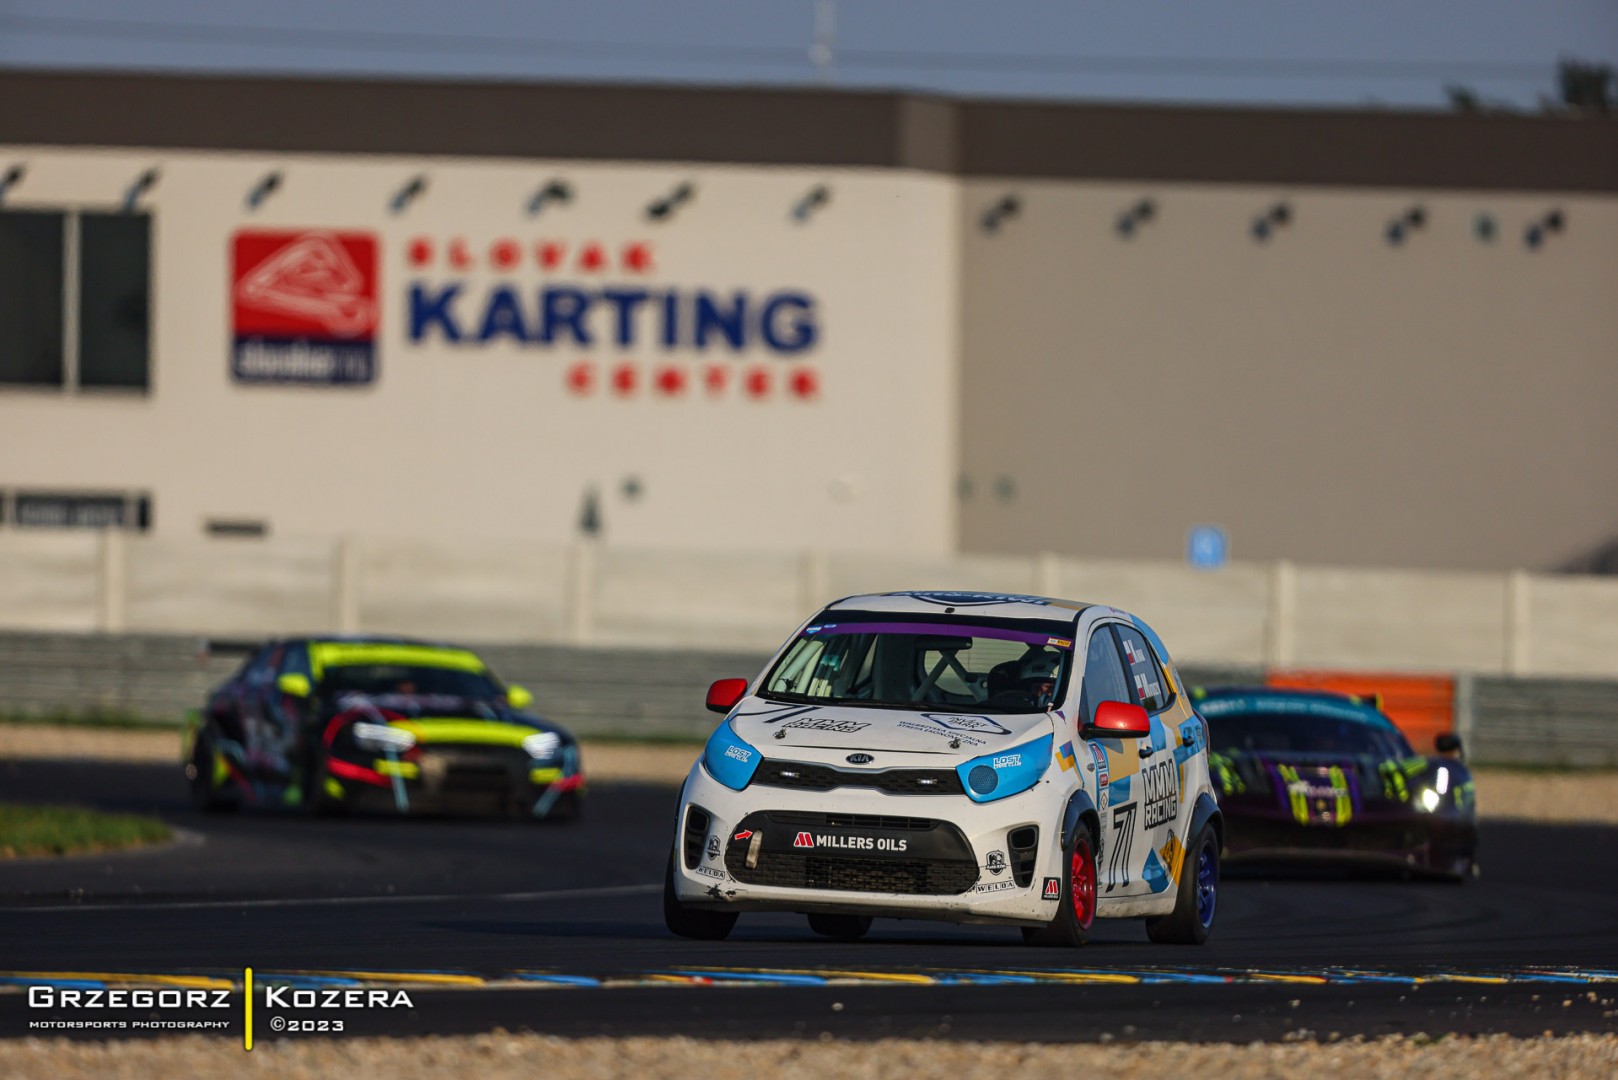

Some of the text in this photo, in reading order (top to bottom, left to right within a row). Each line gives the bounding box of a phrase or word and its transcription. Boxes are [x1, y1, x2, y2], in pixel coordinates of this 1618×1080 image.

[405, 283, 819, 354] KARTING
[728, 745, 752, 757] LOST
[849, 754, 870, 763] KIA
[993, 754, 1021, 765] LOST
[1141, 759, 1177, 806] MMM
[1144, 795, 1177, 831] RACING
[816, 834, 907, 852] MILLERS OILS
[977, 881, 1014, 892] WELDA
